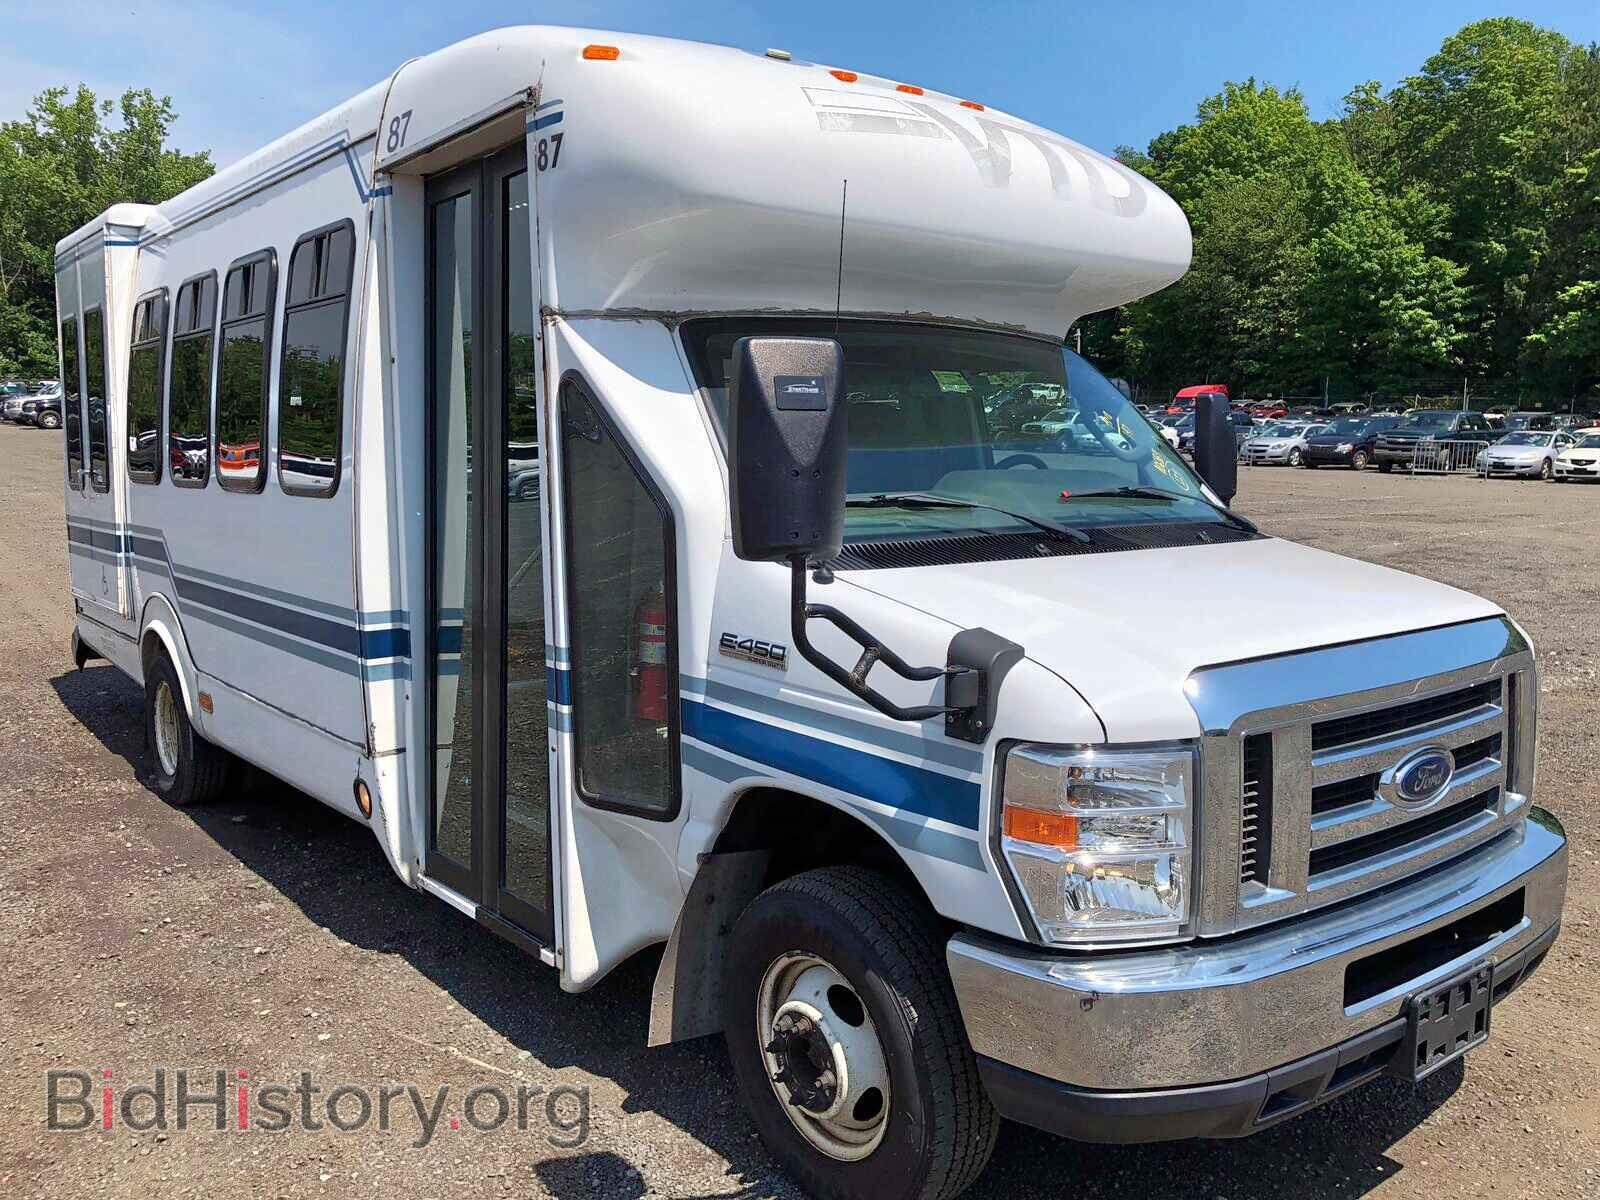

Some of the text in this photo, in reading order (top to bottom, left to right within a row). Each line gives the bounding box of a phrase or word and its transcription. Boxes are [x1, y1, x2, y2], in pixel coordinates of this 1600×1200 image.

[387, 109, 413, 152] 87
[537, 132, 564, 171] 87
[1414, 763, 1445, 792] Ford
